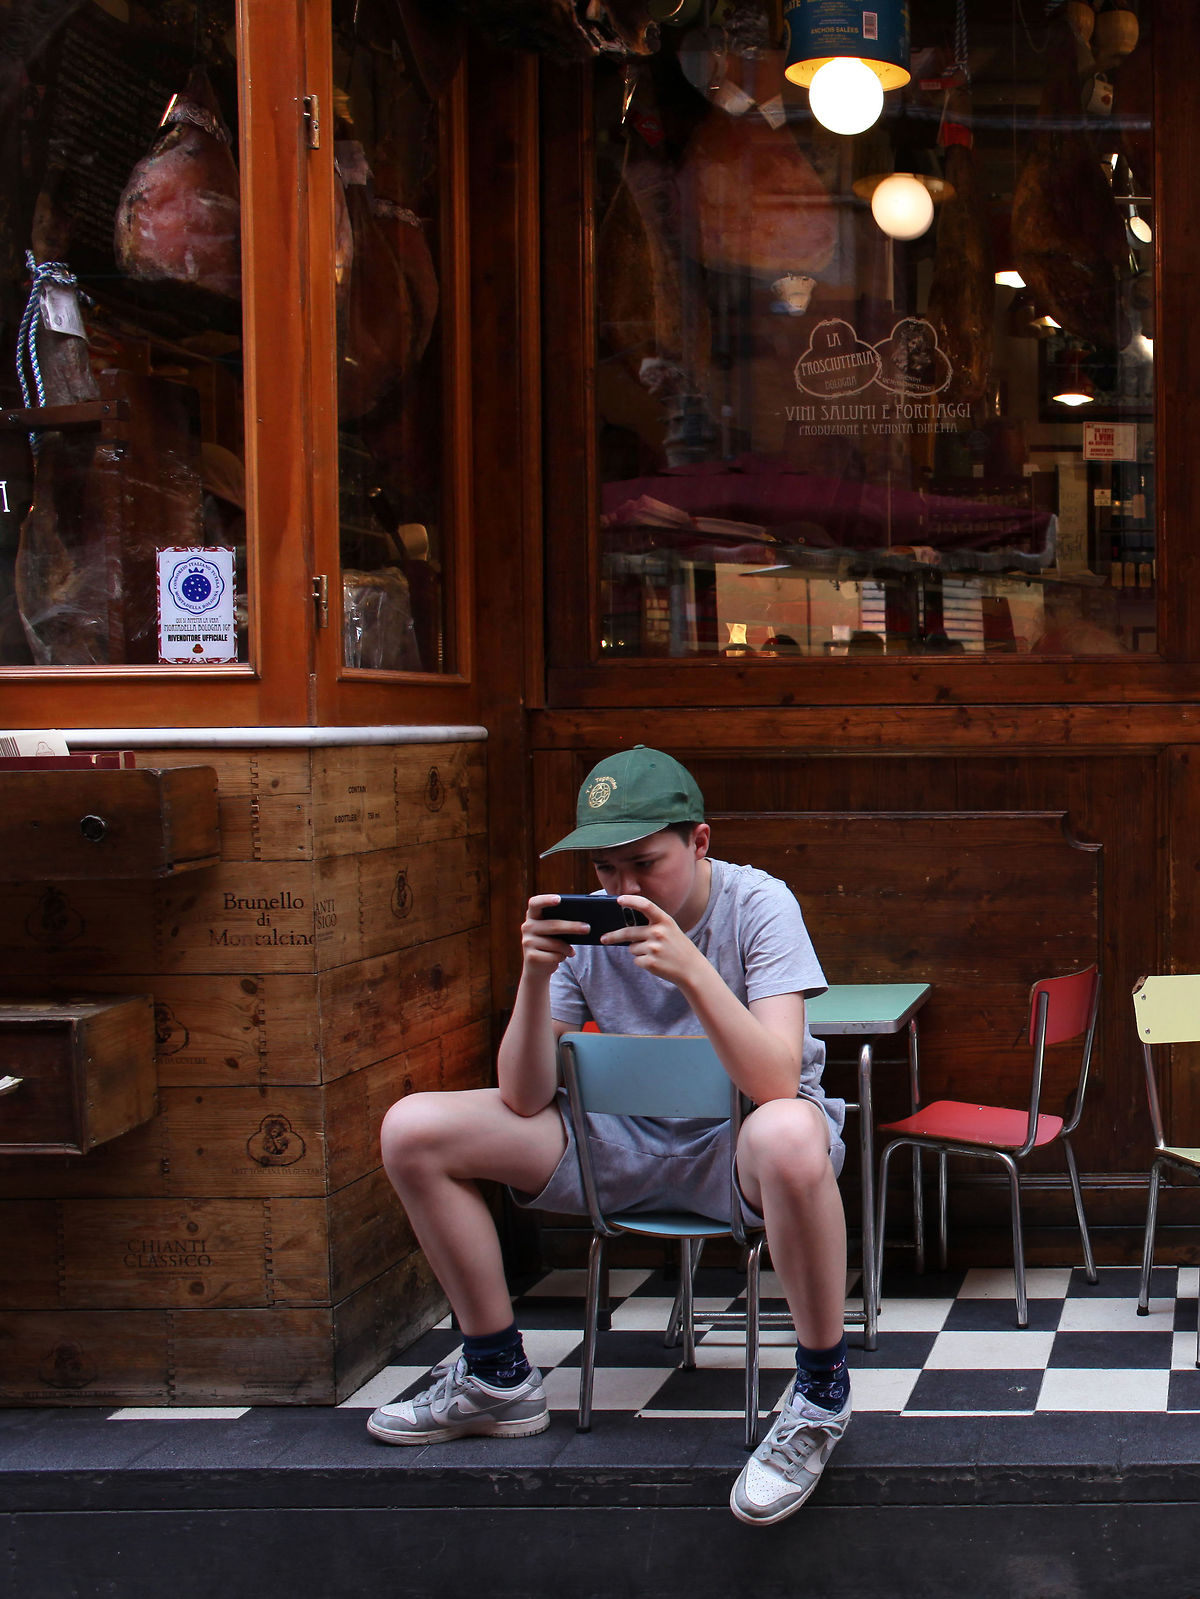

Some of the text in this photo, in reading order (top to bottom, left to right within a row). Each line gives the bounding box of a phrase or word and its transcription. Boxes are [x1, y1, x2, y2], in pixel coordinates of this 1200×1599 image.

[826, 333, 842, 347] LA
[801, 350, 875, 376] PROSCIUTTERIA
[785, 402, 971, 421] VINI SALUMI E FORMAGGI
[799, 424, 859, 436] PRODUZIONE
[863, 424, 868, 435] E
[872, 423, 914, 435] VENDITA
[175, 590, 202, 610] MORTADELLA
[164, 624, 197, 632] MORTADELLA
[198, 624, 222, 632] BOLOGNA
[168, 634, 228, 642] RIVENDITORE UFFICIALE
[223, 891, 305, 910] Brunello
[256, 912, 271, 926] di
[127, 1239, 206, 1252] CHIANTI
[122, 1253, 211, 1268] CLASSICO
